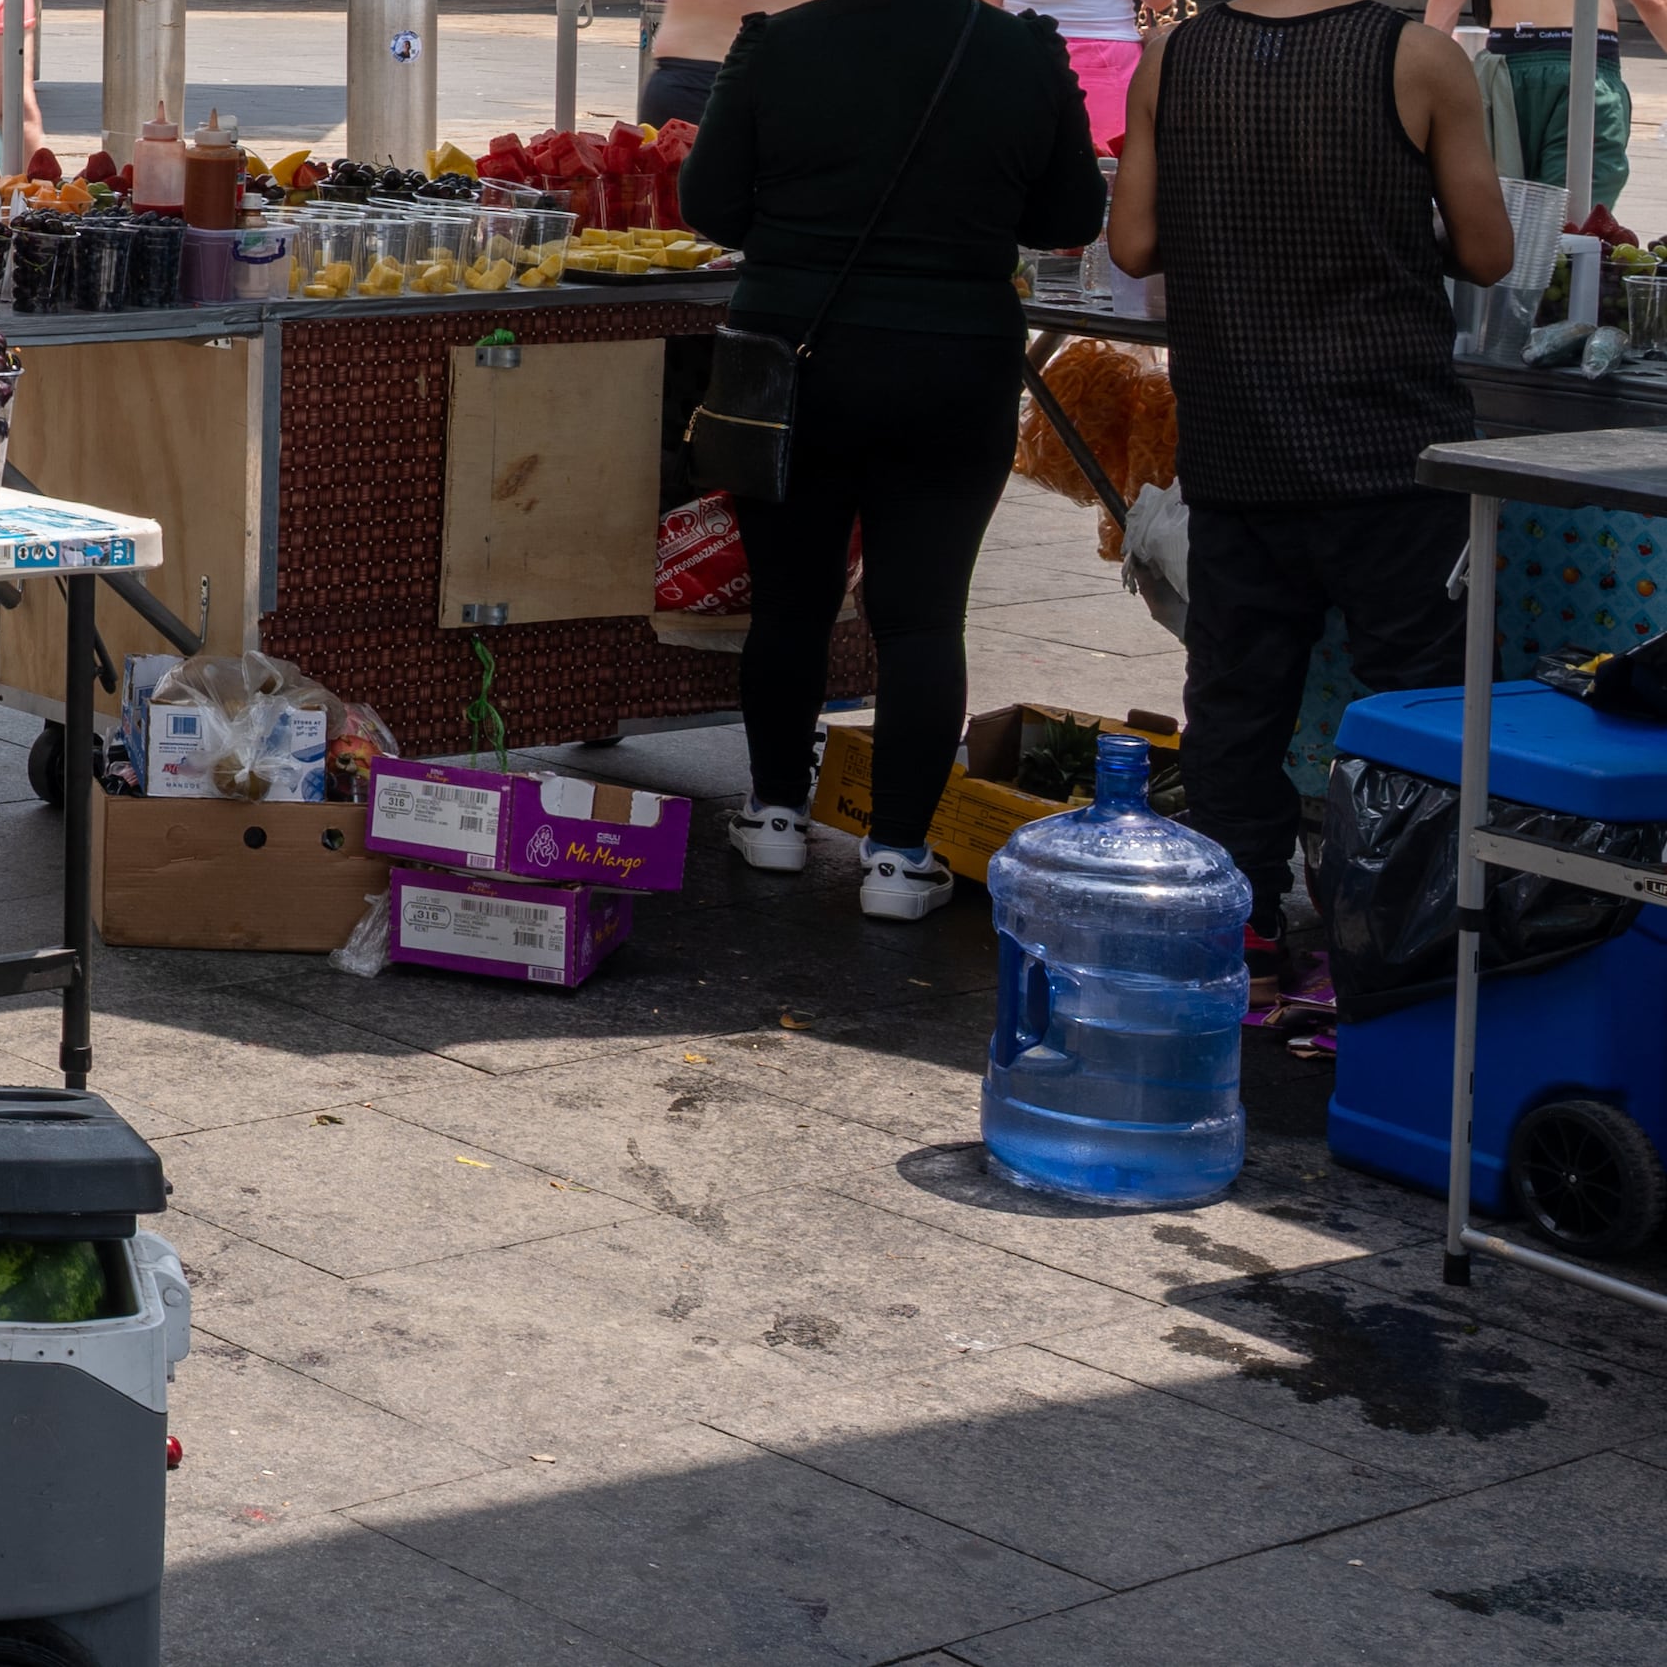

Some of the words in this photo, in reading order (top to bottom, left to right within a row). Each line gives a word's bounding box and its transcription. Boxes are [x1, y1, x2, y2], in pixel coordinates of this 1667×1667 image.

[388, 798, 405, 807] 316
[567, 841, 590, 861] Mr.
[592, 846, 642, 878] Mango
[417, 910, 439, 921] 316
